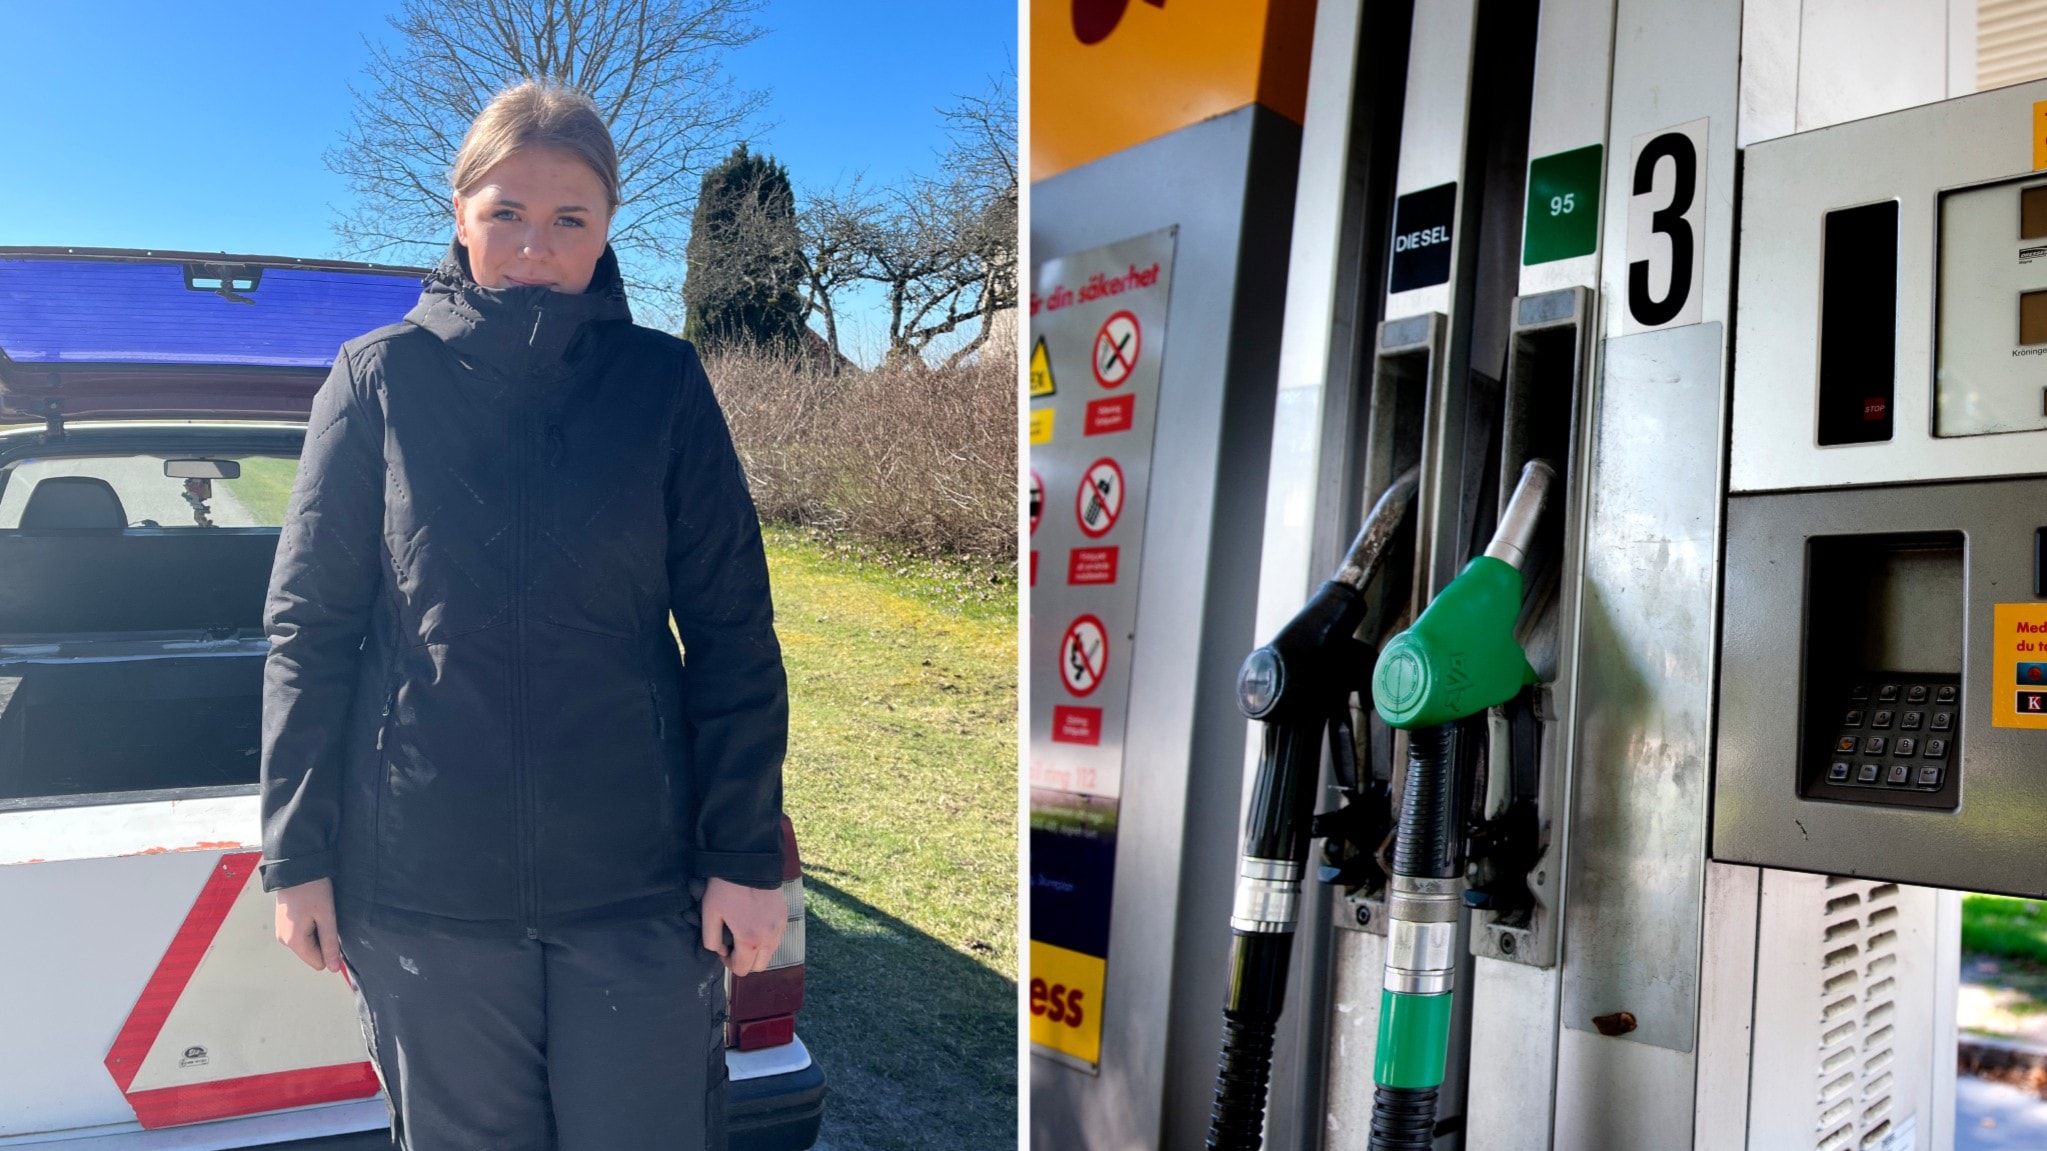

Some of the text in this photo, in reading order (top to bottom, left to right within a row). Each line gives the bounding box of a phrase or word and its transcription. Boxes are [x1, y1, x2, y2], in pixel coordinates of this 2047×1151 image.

[1550, 193, 1575, 216] 95
[1628, 132, 1697, 326] 3
[1395, 225, 1450, 252] DIESEL
[1046, 284, 1074, 311] din
[1078, 262, 1160, 304] säkerhet
[1864, 404, 1885, 413] STOP
[2016, 640, 2034, 652] du
[1915, 687, 1922, 695] 2
[1944, 687, 1951, 695] 3
[2028, 696, 2042, 710] K
[1908, 713, 1915, 721] 5
[1938, 714, 1945, 722] 6
[1873, 739, 1939, 749] 7 8 9
[1896, 767, 1903, 775] 0
[1076, 767, 1097, 789] 112
